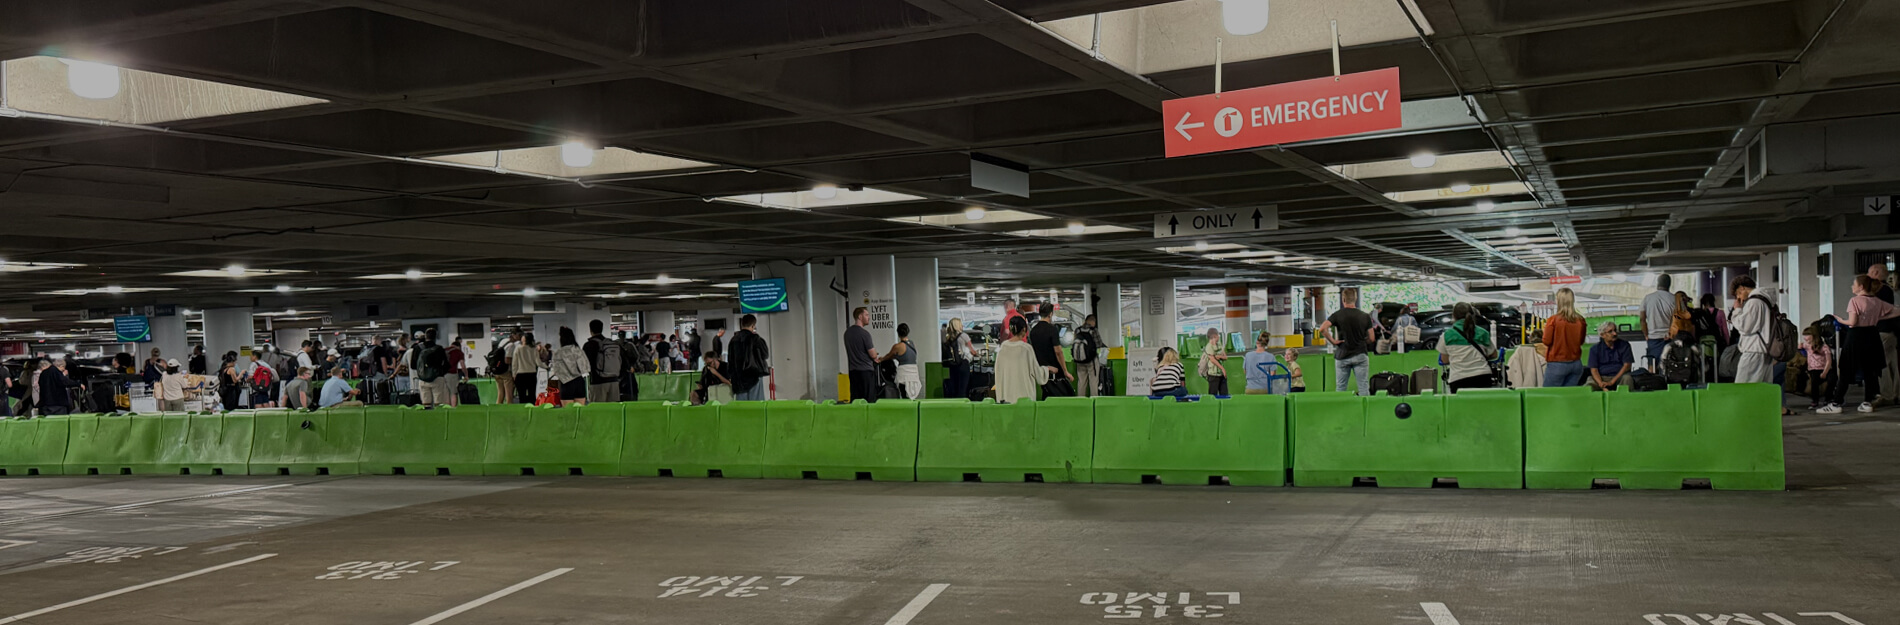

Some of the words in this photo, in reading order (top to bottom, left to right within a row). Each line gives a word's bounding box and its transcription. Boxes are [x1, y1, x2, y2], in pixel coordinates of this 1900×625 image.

[1251, 90, 1389, 128] EMERGENCY
[1192, 212, 1237, 230] ONLY
[1423, 266, 1434, 274] 10
[871, 305, 887, 313] LYFT
[871, 313, 890, 321] UBER
[1132, 359, 1143, 367] Lyft
[326, 561, 461, 571] LIMO
[658, 575, 804, 587] LIMO
[657, 586, 769, 598] 314
[1079, 591, 1241, 605] LIMO
[1103, 605, 1227, 619] 315
